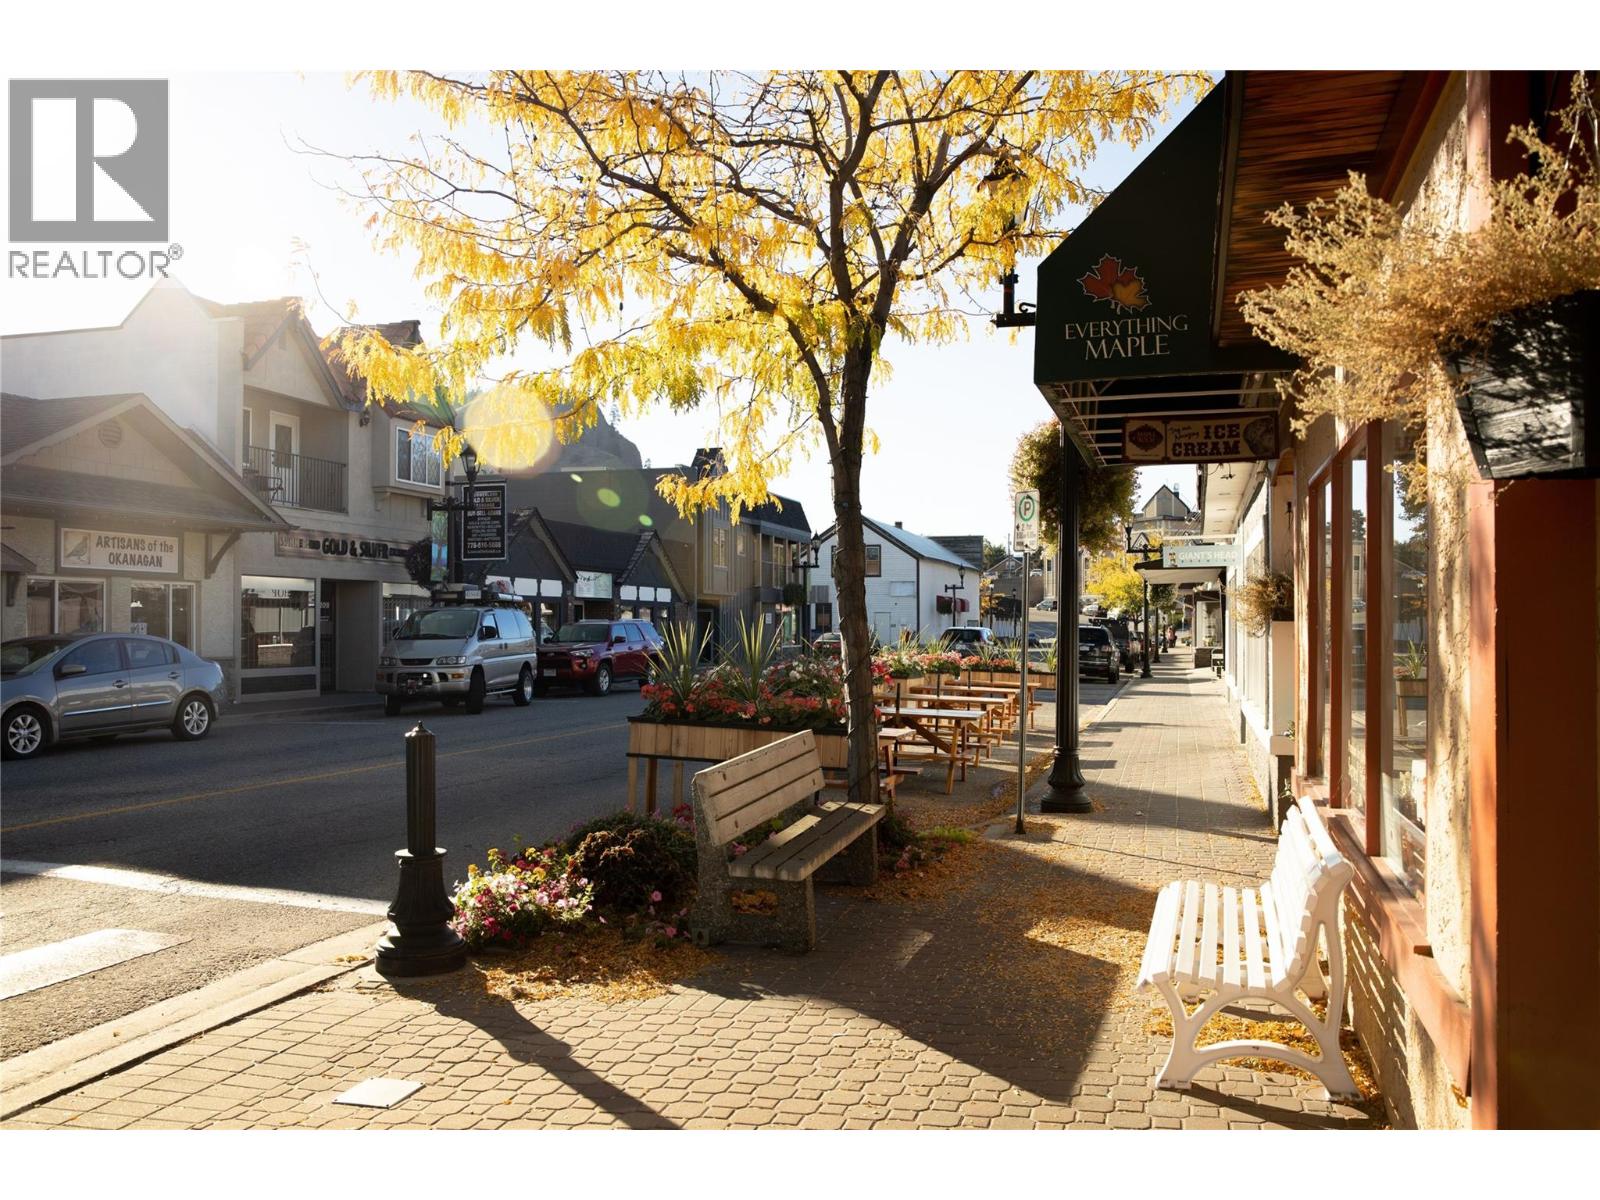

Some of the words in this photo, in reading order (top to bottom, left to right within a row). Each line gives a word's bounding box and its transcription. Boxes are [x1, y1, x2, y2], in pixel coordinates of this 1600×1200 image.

[1065, 314, 1188, 340] EVERYTHING
[1086, 334, 1170, 360] MAPLE
[1203, 424, 1240, 440] ICE
[1172, 440, 1240, 457] CREAM
[95, 535, 146, 551] ARTISANS
[147, 539, 157, 552] of
[159, 540, 174, 553] the
[322, 538, 348, 556] GOLD
[349, 540, 358, 557] &
[359, 541, 389, 559] SILVER
[108, 553, 163, 568] OKANAGAN
